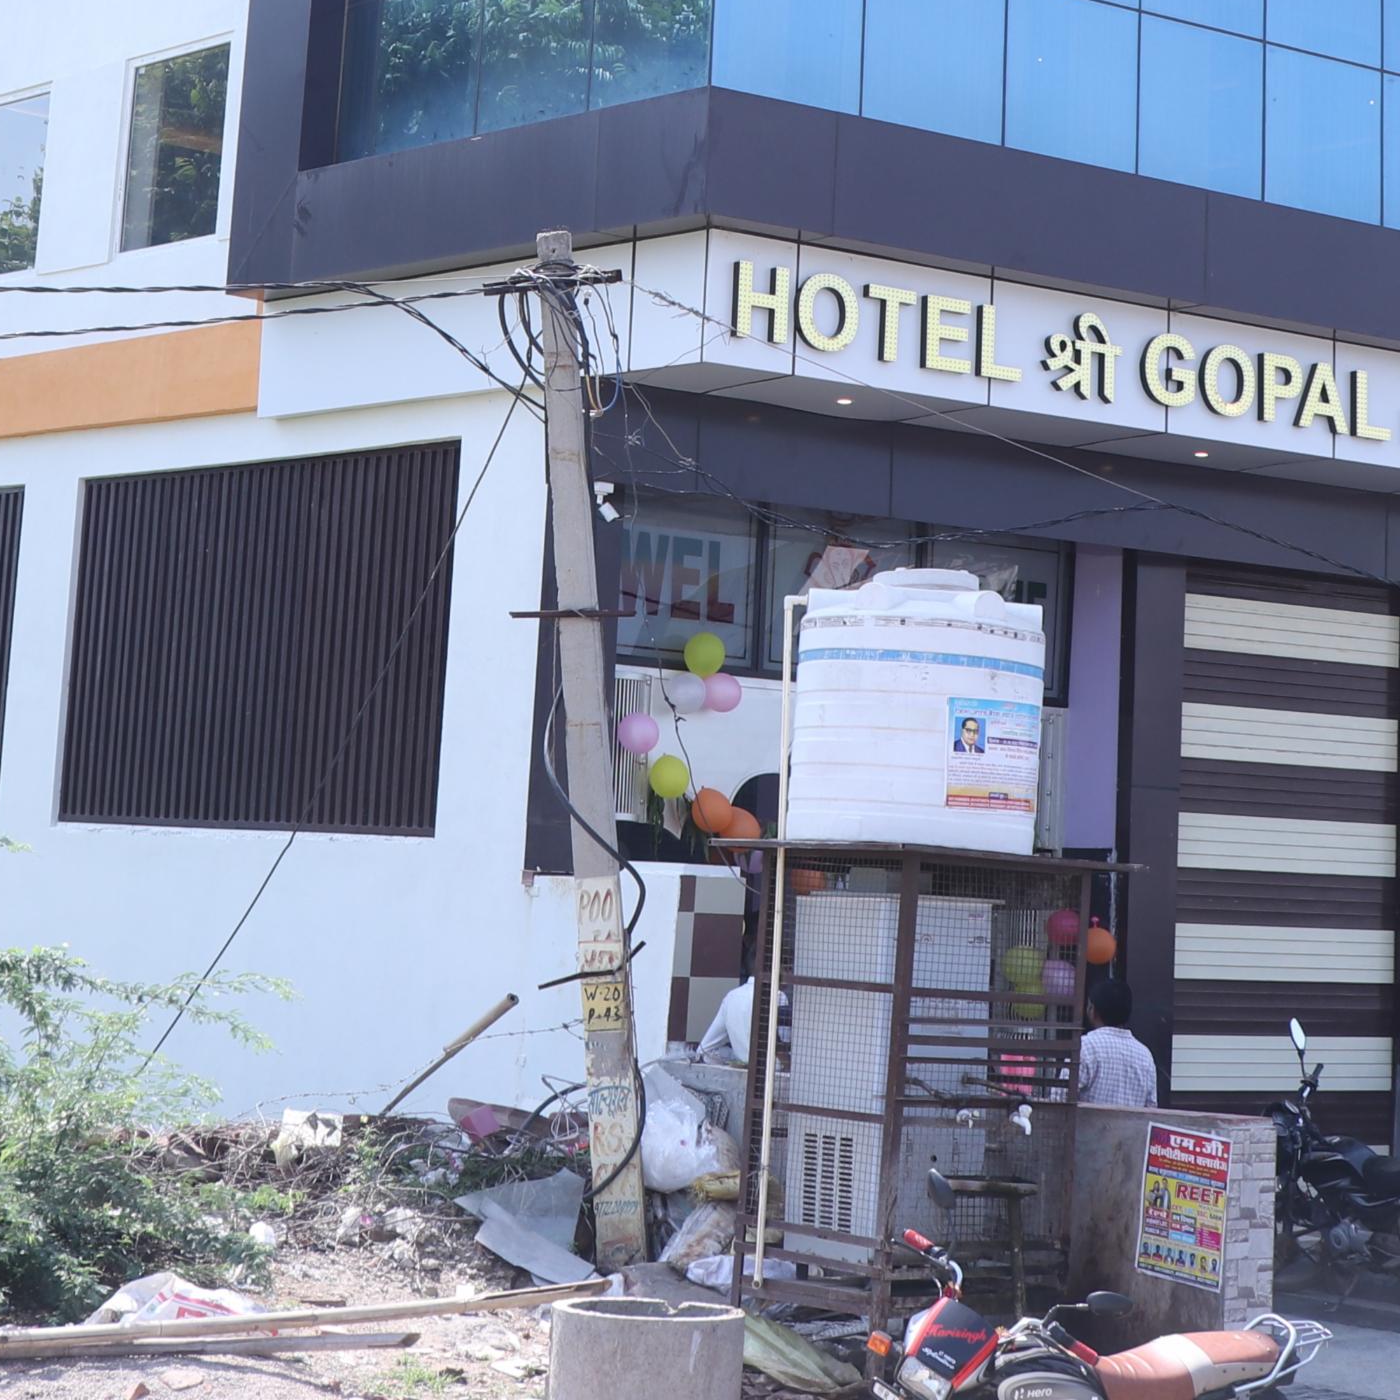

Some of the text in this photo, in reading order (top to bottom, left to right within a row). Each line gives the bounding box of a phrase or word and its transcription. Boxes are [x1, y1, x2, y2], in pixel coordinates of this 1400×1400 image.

[731, 259, 1392, 441] HOTEL श्री GOPAL
[1176, 1182, 1224, 1205] REET
